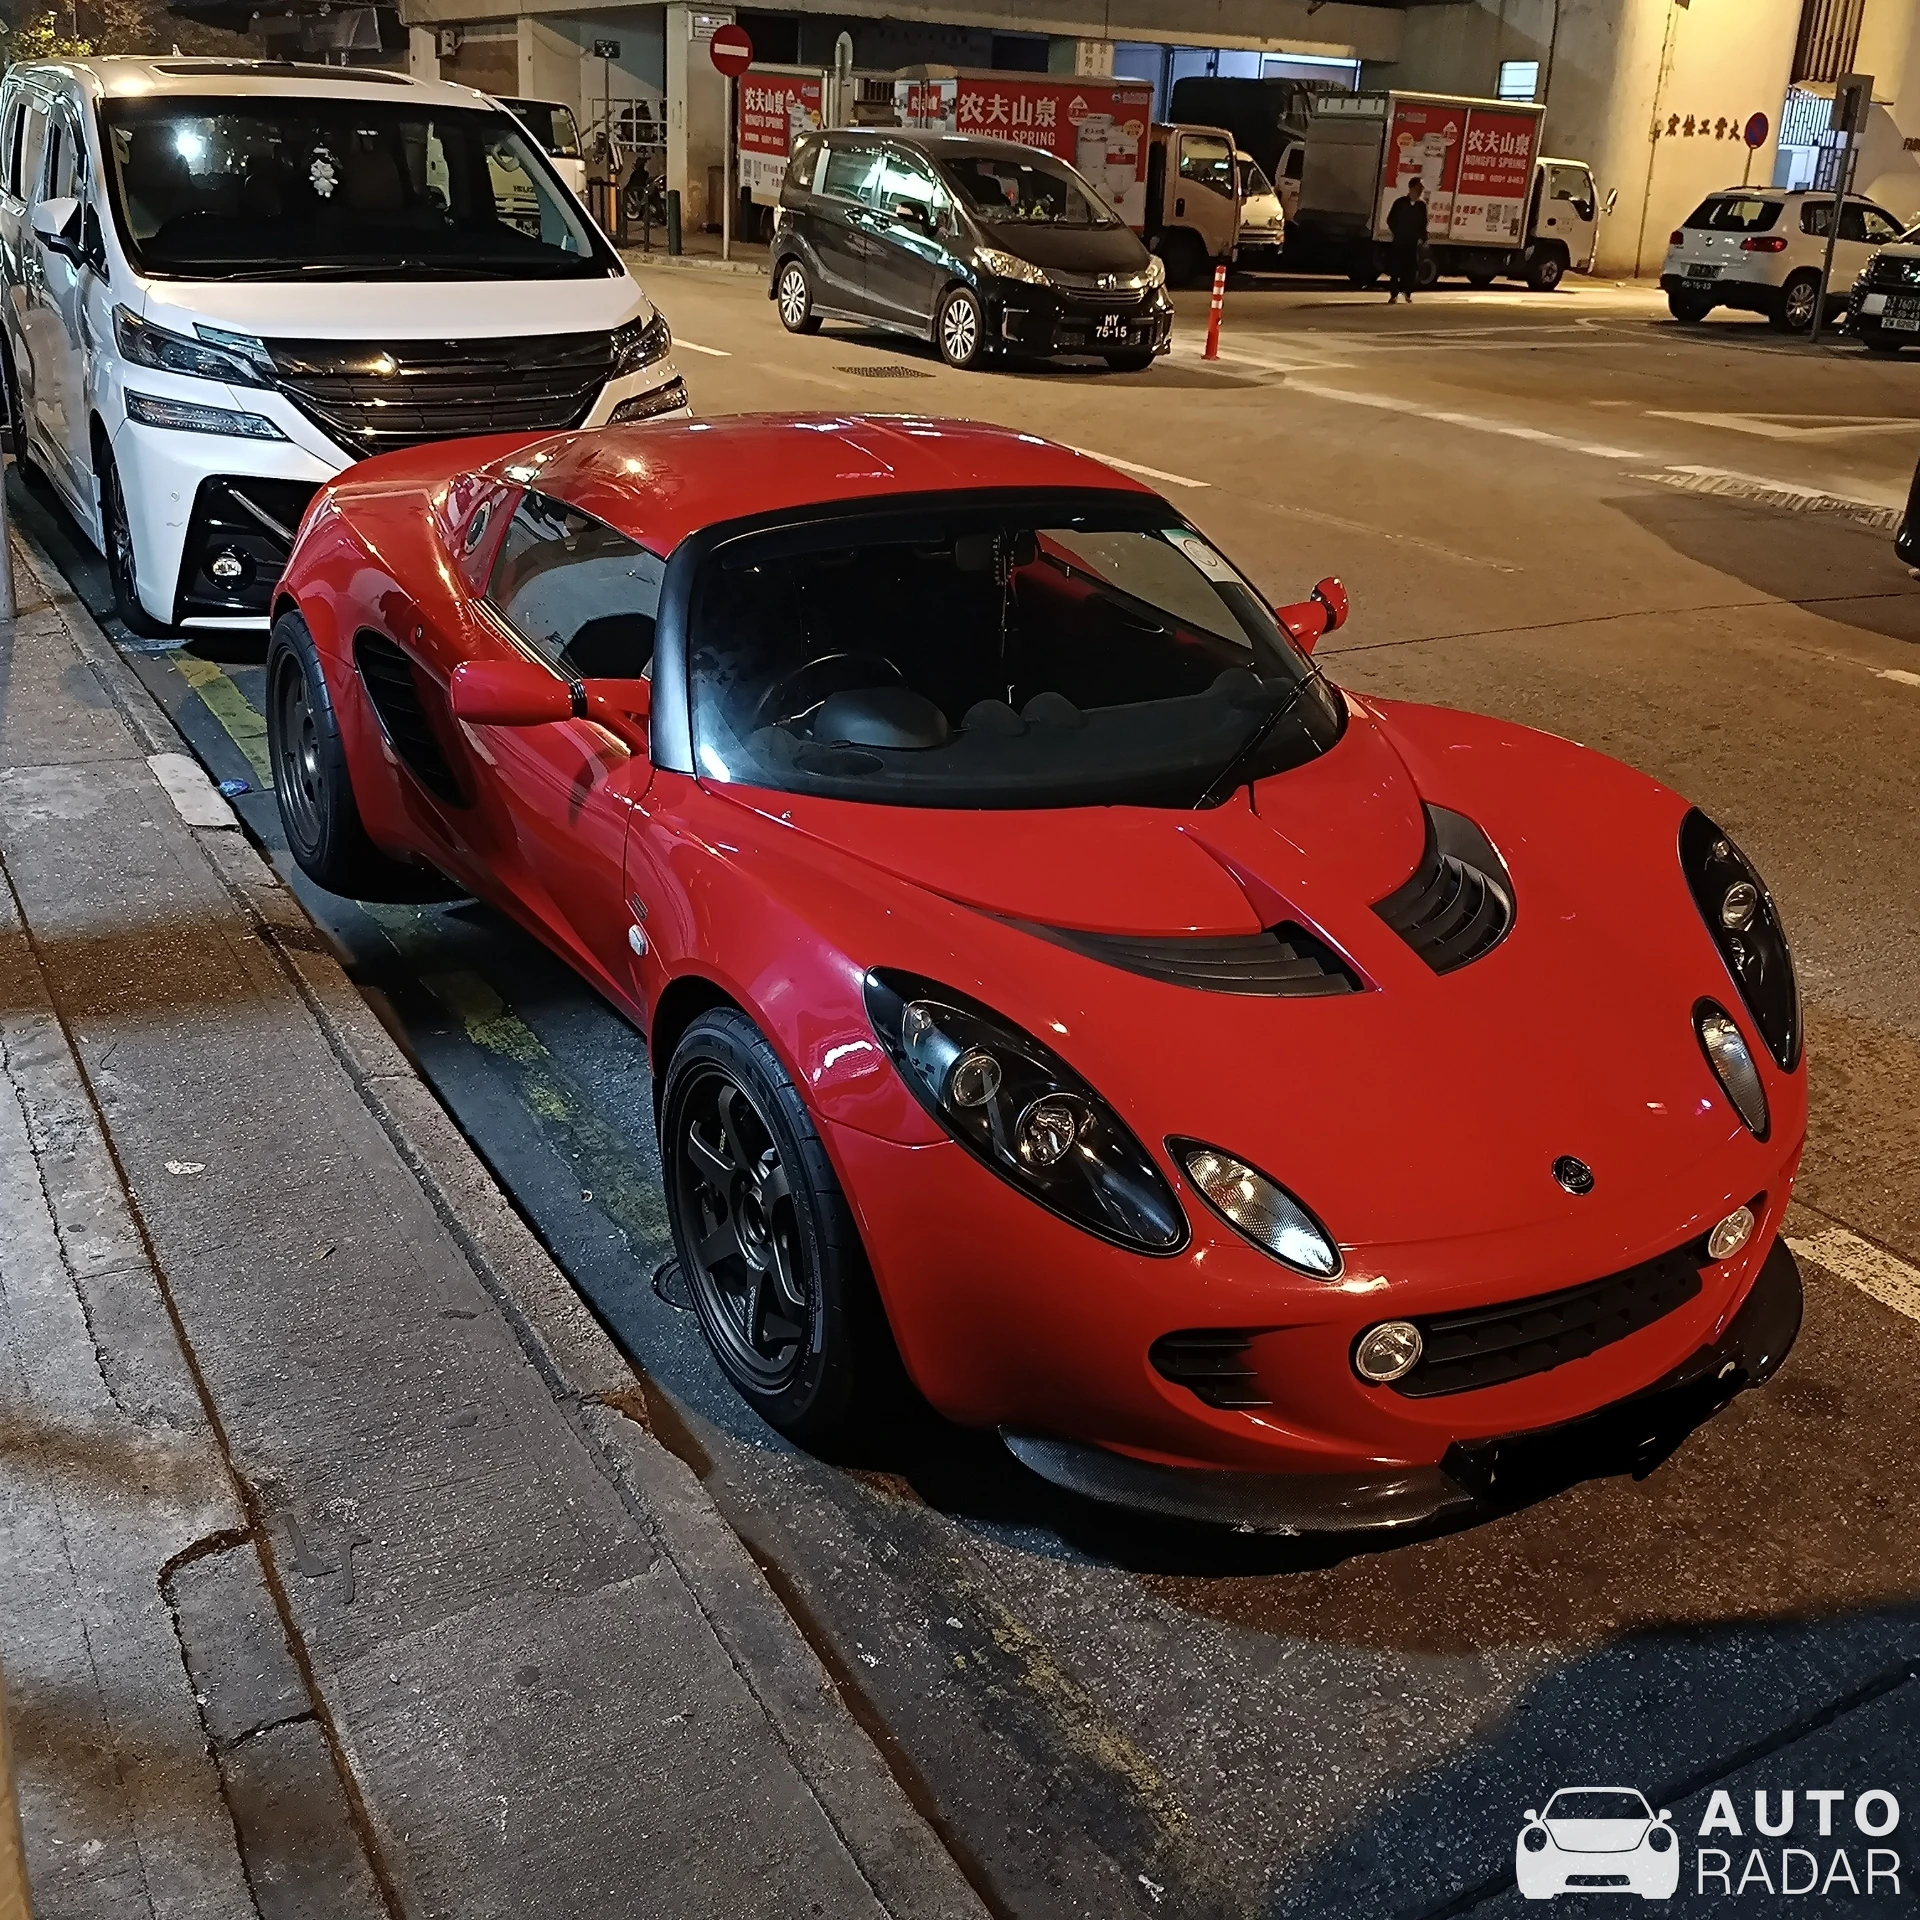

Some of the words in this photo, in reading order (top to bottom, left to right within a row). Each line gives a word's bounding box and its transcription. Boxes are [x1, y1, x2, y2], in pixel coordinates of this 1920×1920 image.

[745, 87, 784, 115] 农夫山泉
[959, 92, 1058, 128] 农夫山泉
[1012, 130, 1056, 146] SPRING
[1467, 129, 1530, 156] 农夫山泉
[1104, 314, 1119, 327] MY
[1095, 326, 1127, 338] 75-15
[1565, 1171, 1589, 1184] LOTUS
